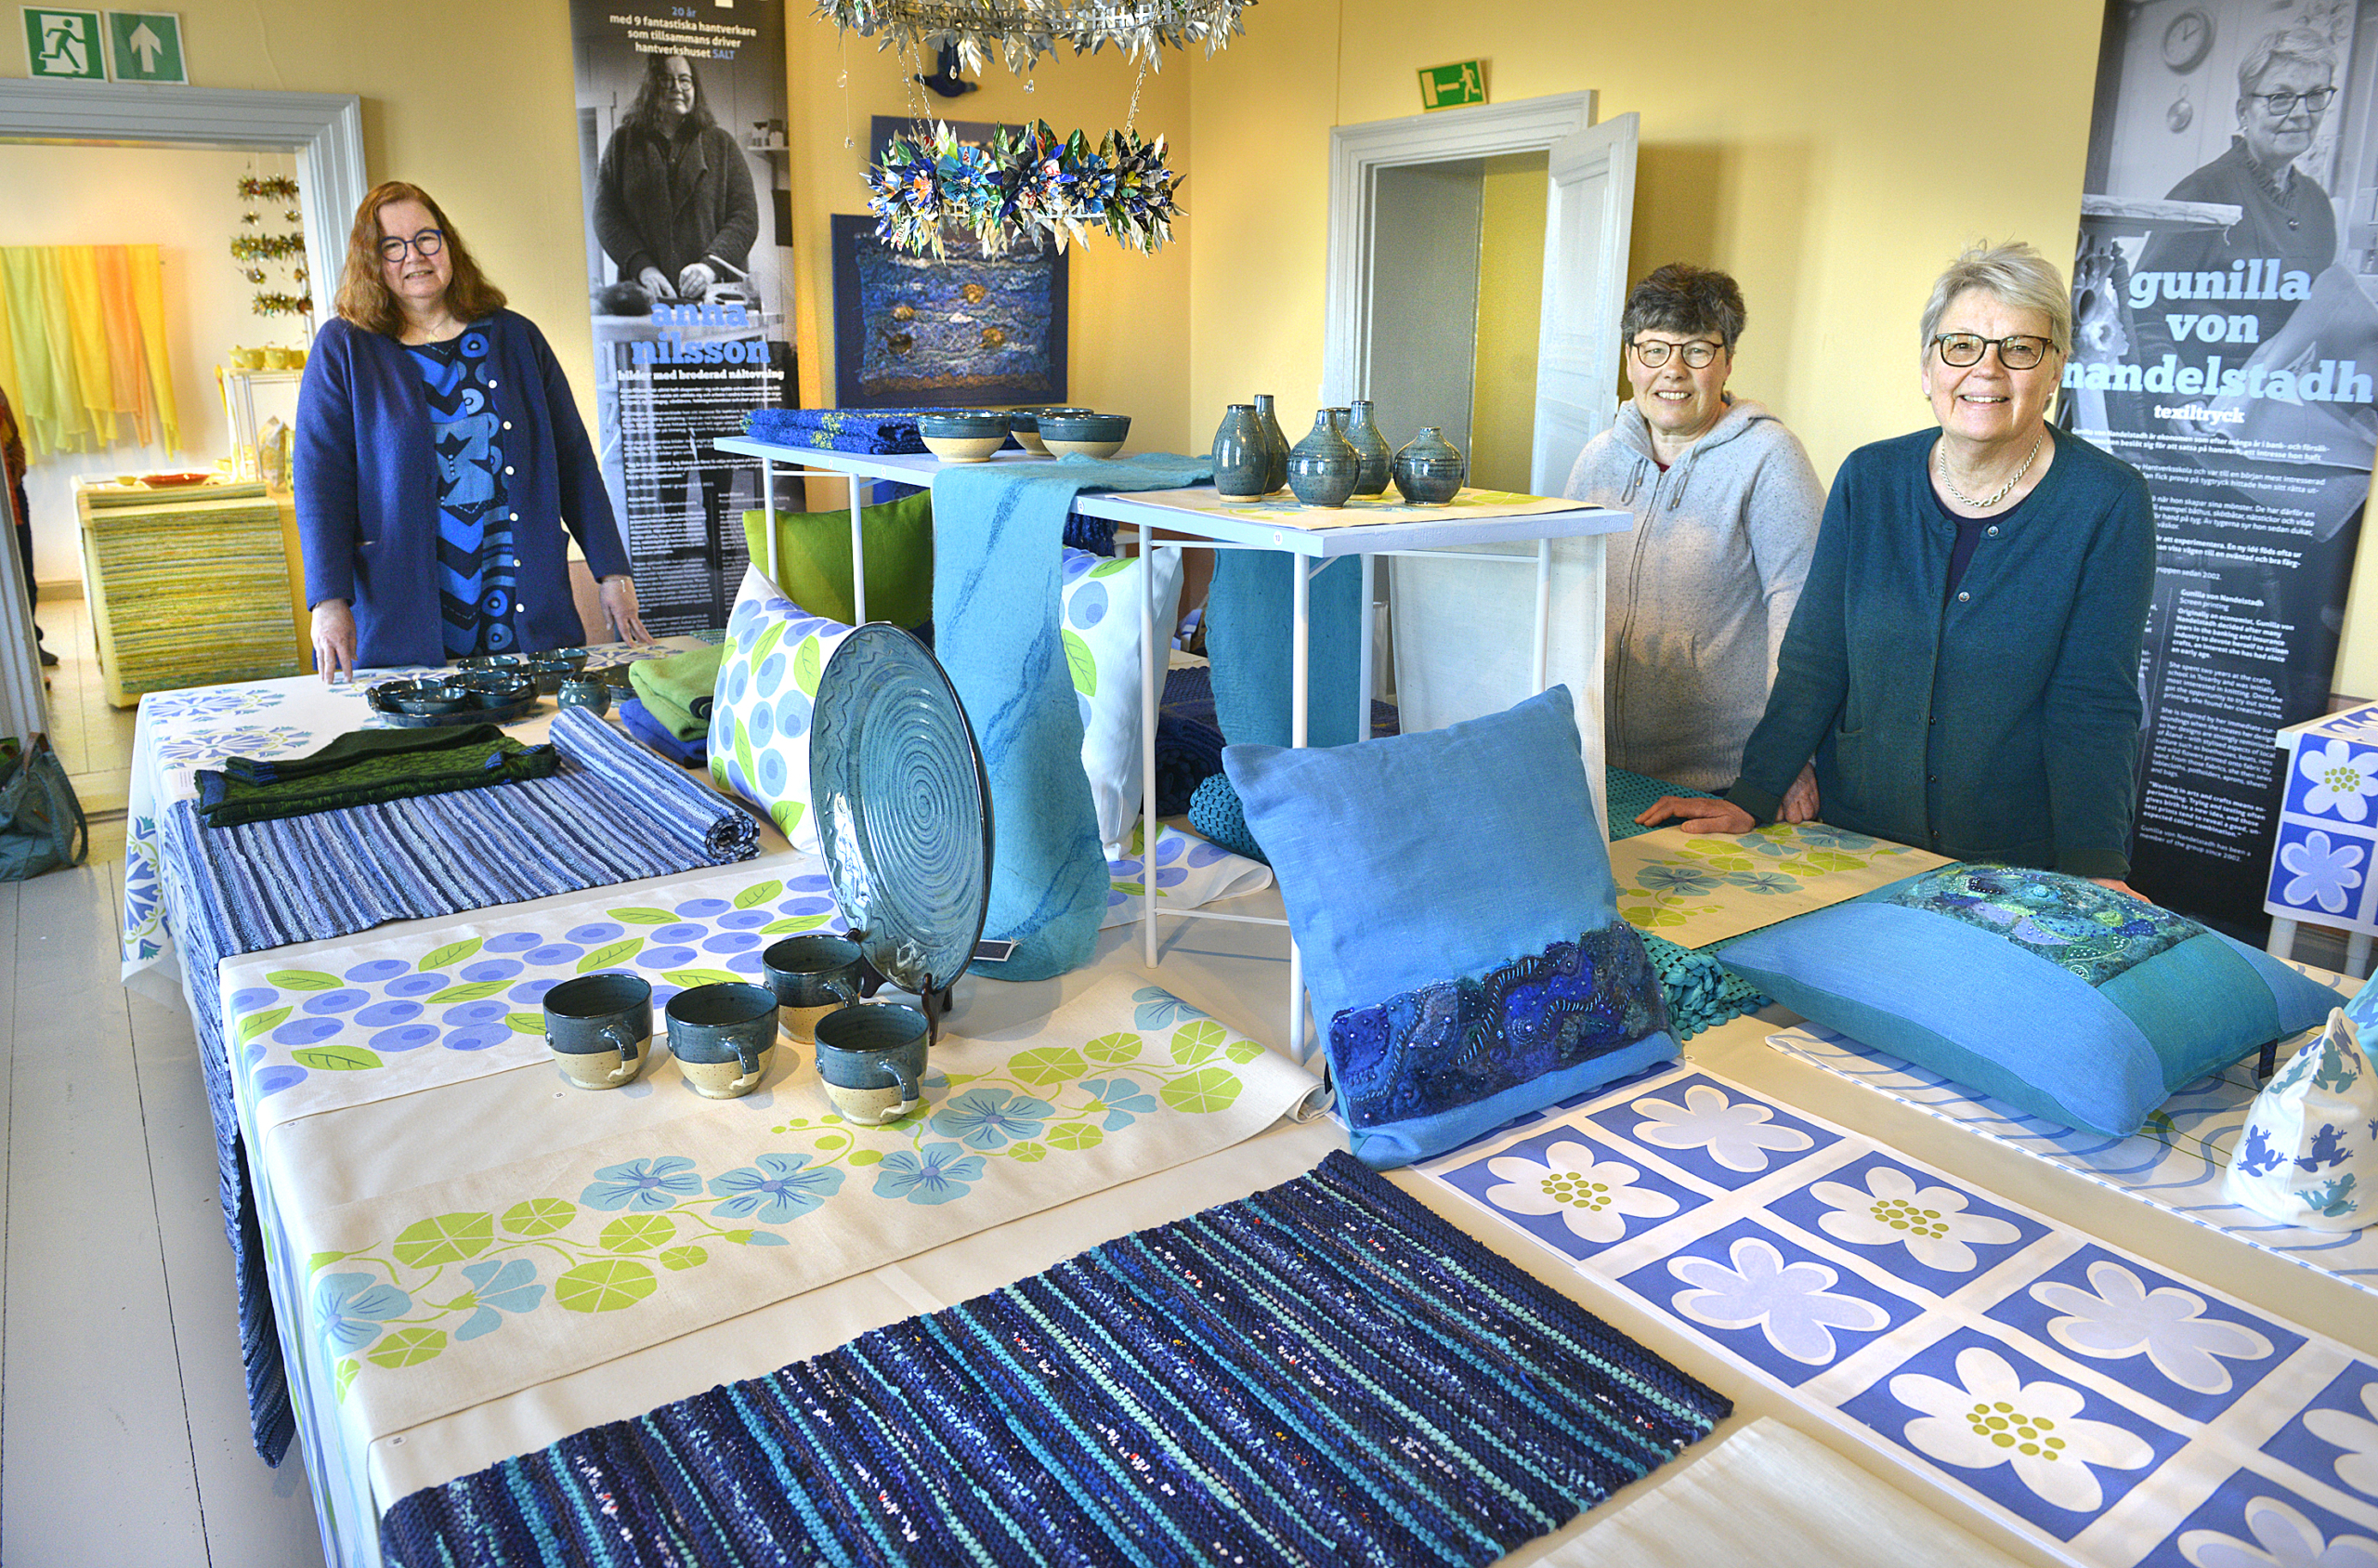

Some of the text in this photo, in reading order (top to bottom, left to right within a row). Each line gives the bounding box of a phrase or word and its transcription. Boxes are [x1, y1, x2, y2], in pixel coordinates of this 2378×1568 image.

[672, 7, 697, 17] 20 år
[609, 13, 757, 37] med 9 fantastiska hantverkare
[627, 30, 741, 48] som tillsammans driver
[635, 42, 736, 60] hantverkshuset SALT
[2127, 258, 2311, 308] gunilla
[650, 302, 749, 326] anna
[2165, 313, 2259, 344] von
[631, 332, 771, 365] nilsson
[618, 368, 784, 381] bilder med broderad nåltovning
[2061, 354, 2373, 403] nandelstadh
[2153, 404, 2244, 425] texiltryck
[2107, 430, 2148, 439] Nandelstadh
[2157, 433, 2193, 442] ekonomen
[2228, 439, 2252, 447] många
[2174, 538, 2226, 549] experimentera.
[2260, 547, 2276, 555] föds
[2183, 547, 2203, 556] vägen
[2226, 553, 2254, 561] oväntad
[2282, 559, 2301, 568] färg-
[2202, 572, 2222, 580] 2002.
[2179, 597, 2229, 612] Screen printing
[2180, 589, 2205, 598] Gunilla
[2220, 594, 2264, 607] Nandelstadh
[2176, 615, 2282, 639] Nandelstadh decided after many
[2177, 607, 2209, 620] Originally
[2219, 614, 2255, 626] economist,
[2256, 619, 2280, 629] Gunilla
[2174, 630, 2200, 642] industry
[2209, 636, 2231, 645] devote
[2232, 639, 2256, 649] herself
[2265, 646, 2289, 655] artisan
[2213, 629, 2238, 640] banking
[2253, 635, 2285, 646] insurance
[2173, 639, 2193, 648] crafts,
[2203, 643, 2228, 653] interest
[2253, 651, 2266, 659] had
[2267, 654, 2285, 662] since
[2180, 648, 2197, 657] early
[2167, 670, 2188, 678] school
[2197, 674, 2221, 685] Tosarby
[2250, 683, 2276, 695] initially
[2182, 664, 2200, 672] spent
[2252, 676, 2272, 684] crafts
[2183, 679, 2215, 691] interested
[2224, 686, 2251, 698] knitting.
[2252, 691, 2269, 700] Once
[2189, 689, 2226, 702] opportunity
[2235, 696, 2245, 706] try
[2258, 702, 2281, 710] screen
[2164, 692, 2190, 703] printing,
[2204, 699, 2223, 708] found
[2235, 706, 2262, 715] creative
[2263, 710, 2284, 719] niche.
[2146, 796, 2163, 805] gives
[2164, 799, 2180, 809] birth
[2209, 809, 2225, 820] idea,
[2240, 816, 2259, 826] those
[2147, 789, 2188, 804] perimenting.
[2189, 797, 2209, 809] Trying
[2223, 805, 2246, 817] testing
[2247, 811, 2266, 820] often
[2213, 796, 2231, 804] crafts
[2232, 800, 2254, 809] means
[2143, 810, 2173, 822] expected
[2174, 817, 2194, 827] colour
[2144, 802, 2157, 811] test
[2158, 806, 2177, 816] prints
[2179, 810, 2194, 819] tend
[2203, 817, 2223, 826] reveal
[2229, 822, 2248, 832] good,
